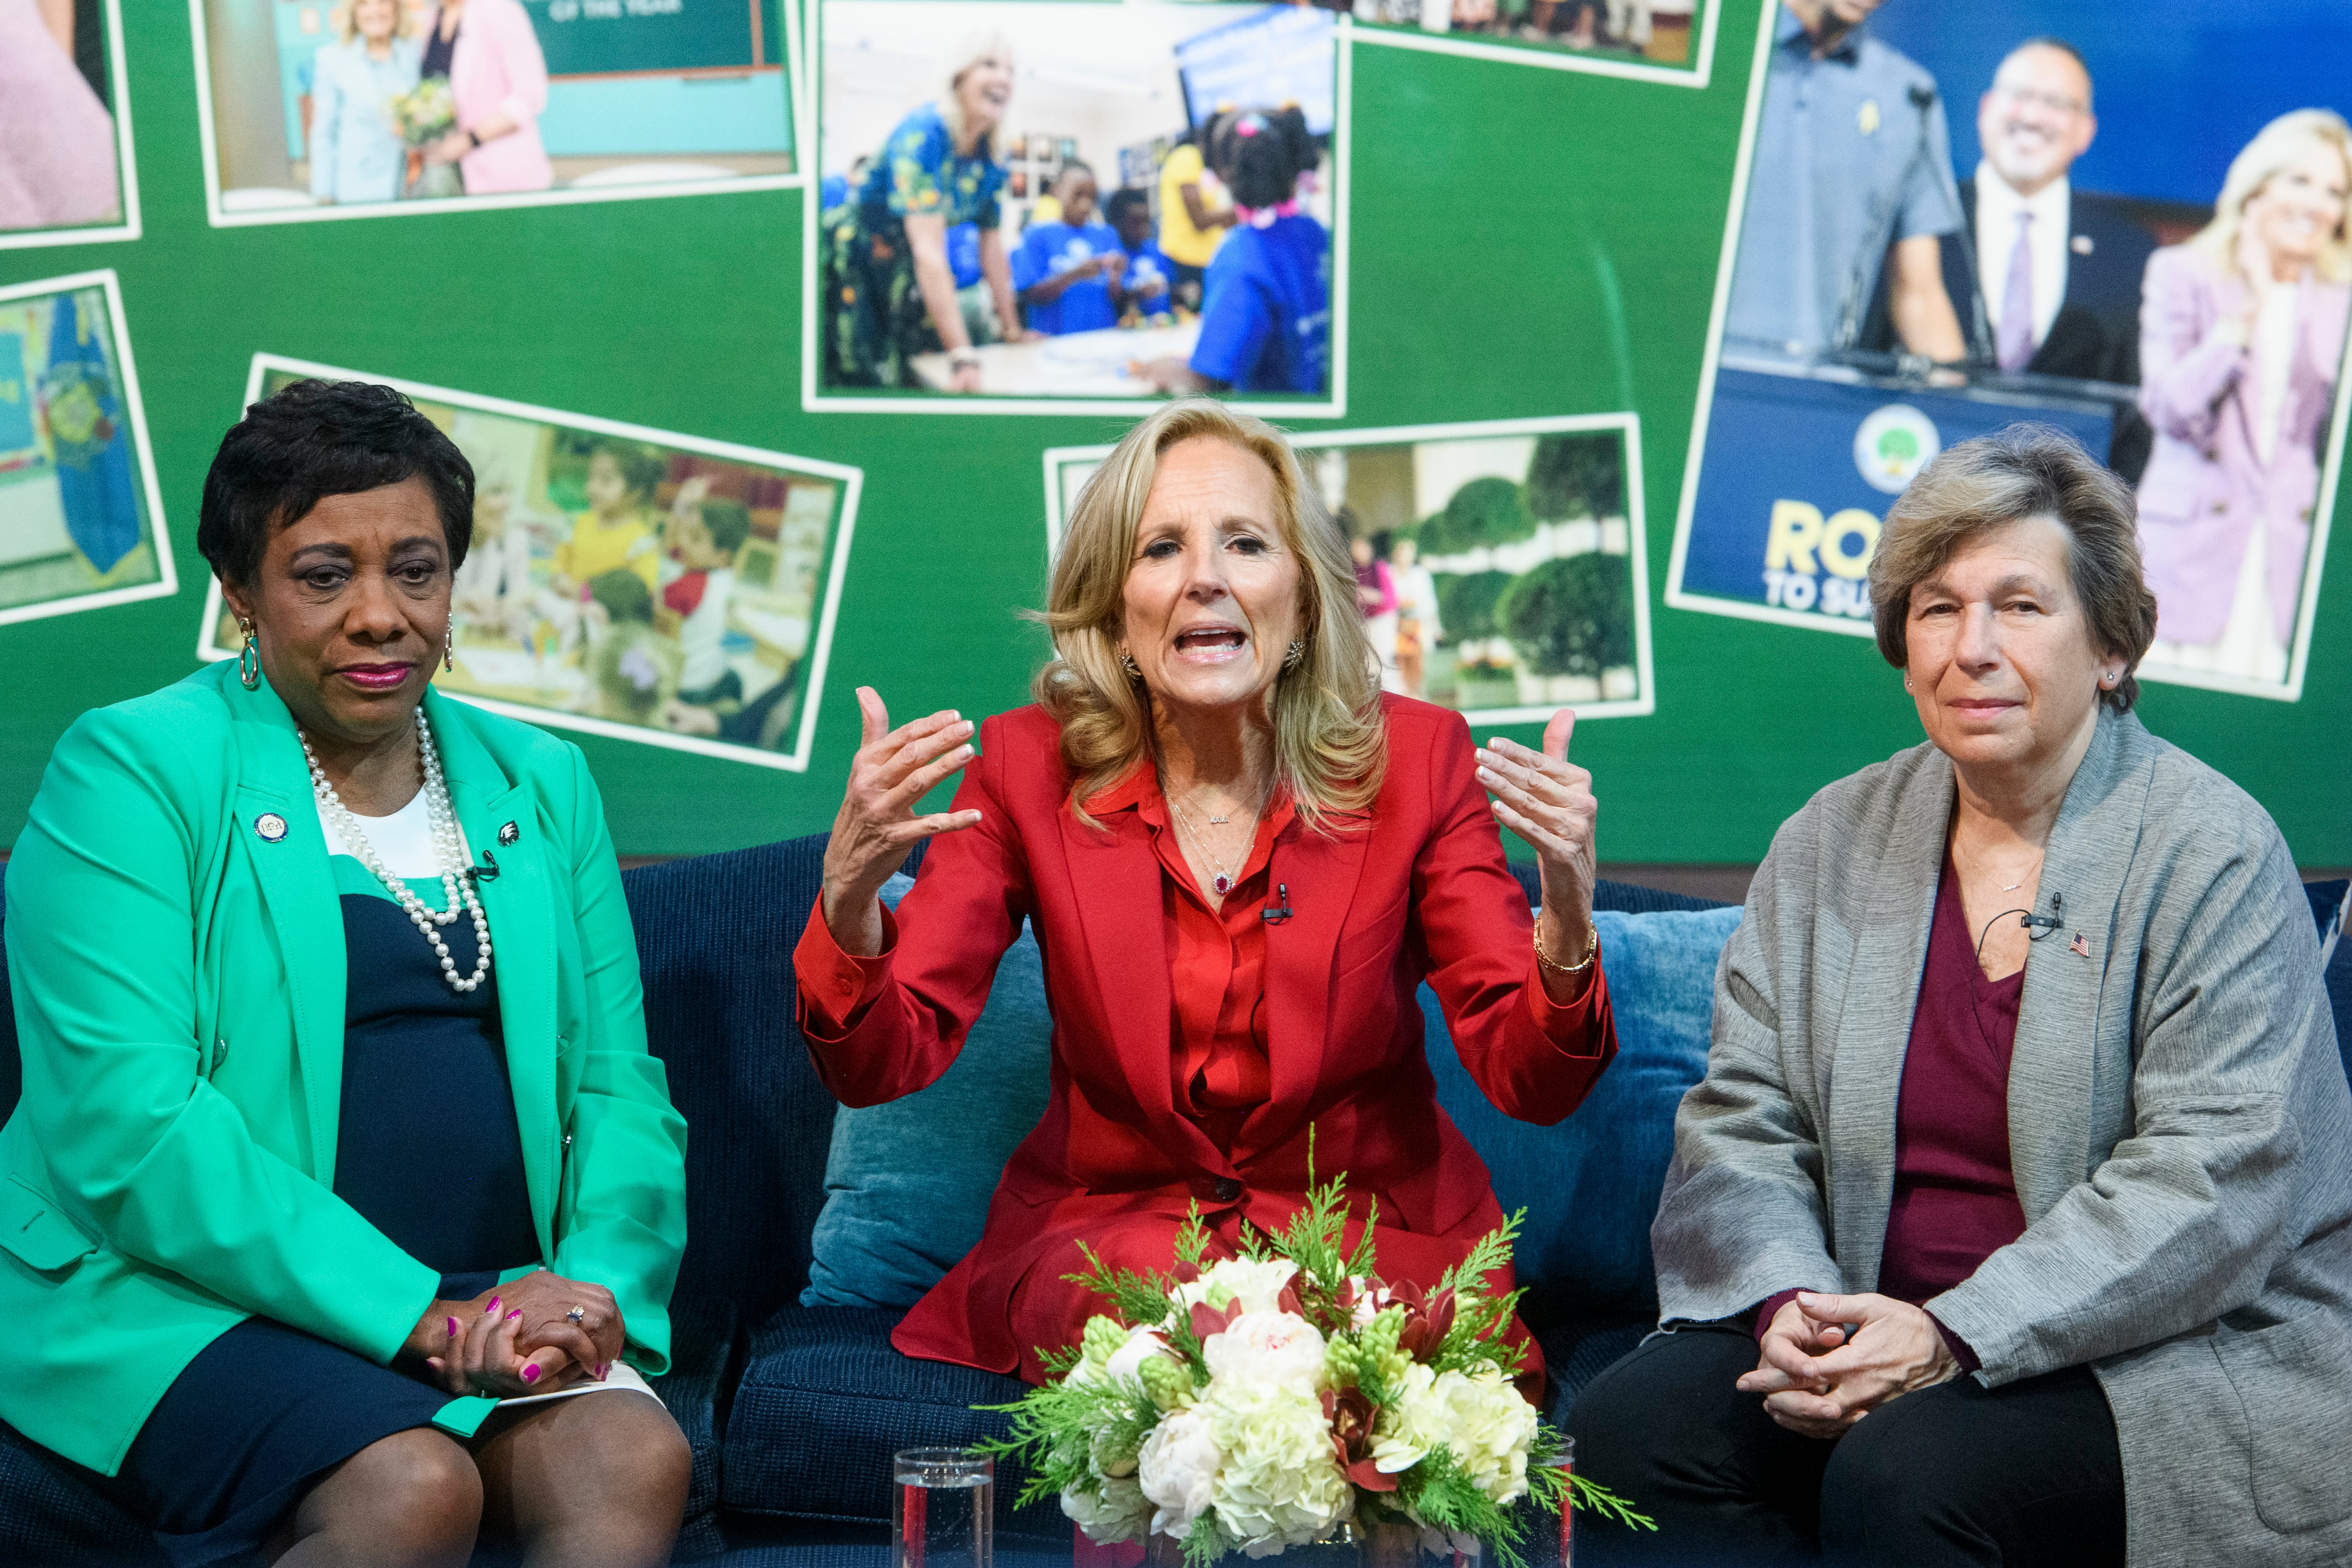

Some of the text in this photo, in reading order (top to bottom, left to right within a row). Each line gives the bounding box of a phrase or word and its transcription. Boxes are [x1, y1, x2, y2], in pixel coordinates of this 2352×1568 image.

[548, 0, 683, 22] OF THE YEAR
[1763, 569, 1816, 609] TO
[261, 821, 283, 832] nea
